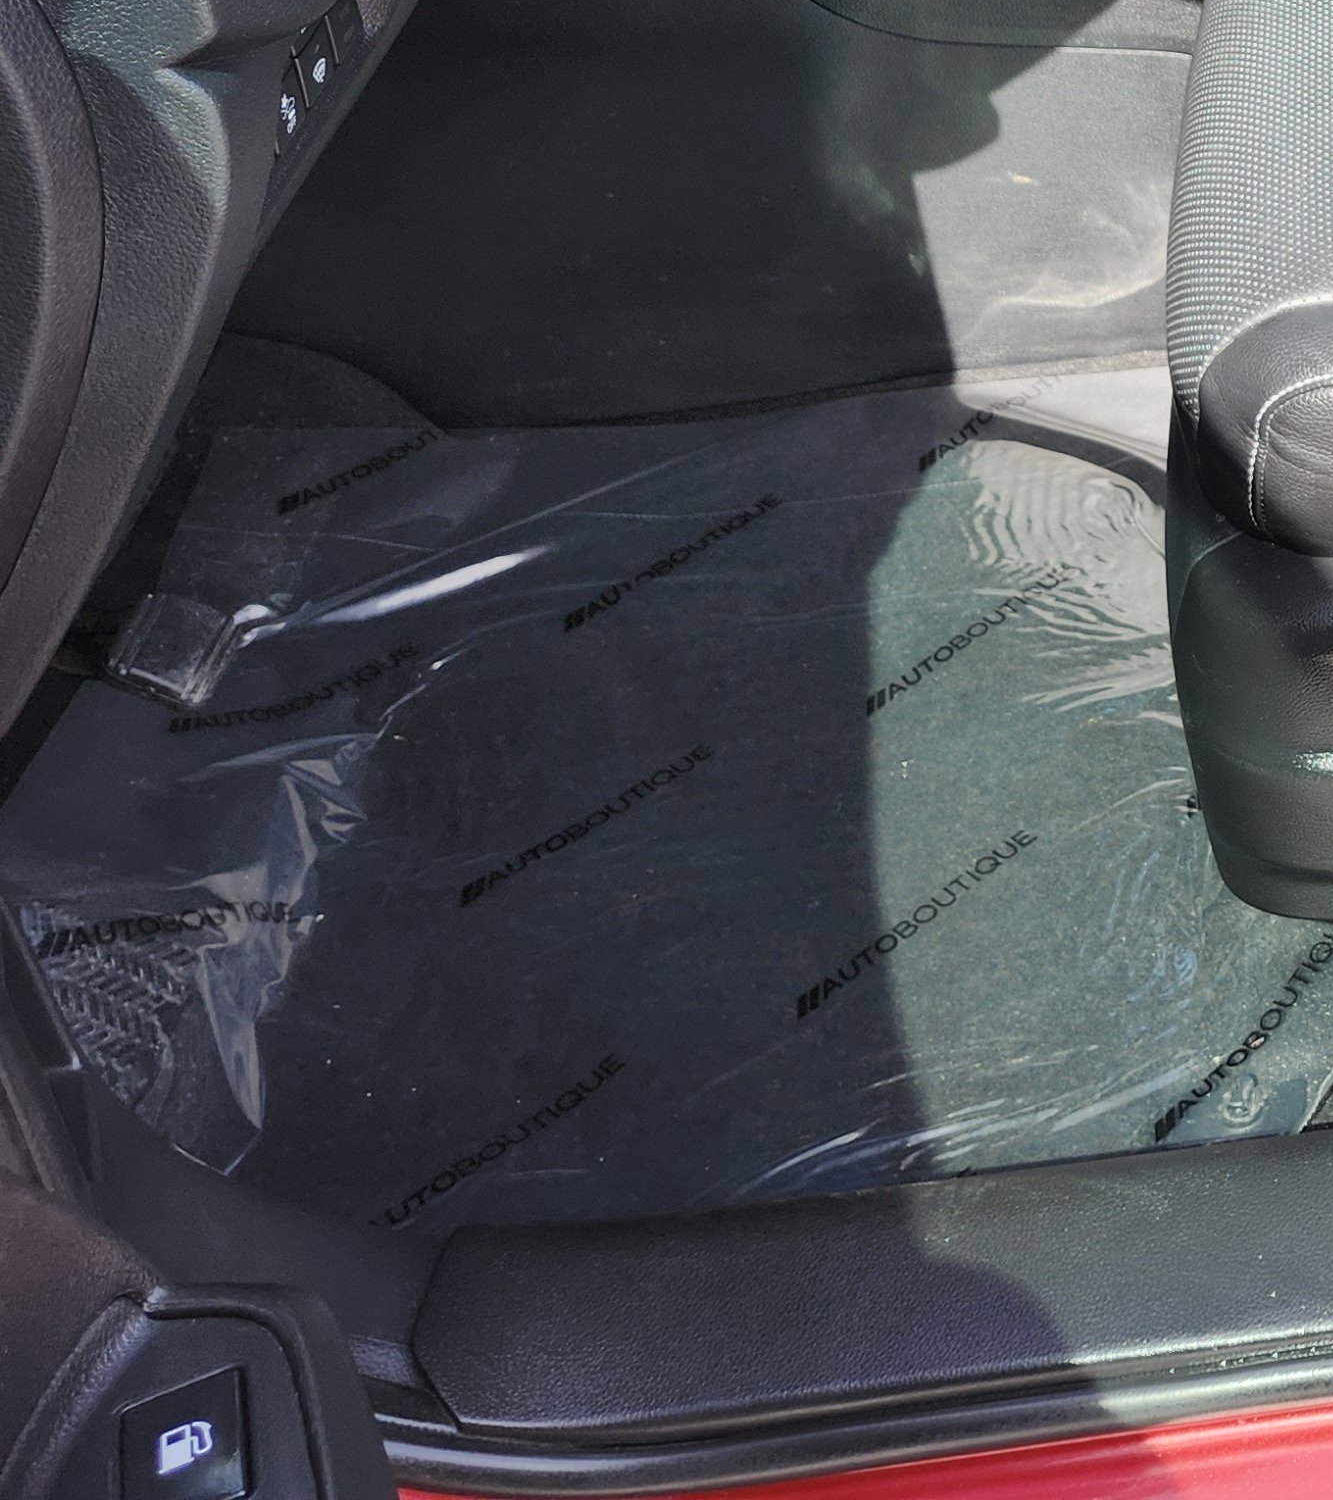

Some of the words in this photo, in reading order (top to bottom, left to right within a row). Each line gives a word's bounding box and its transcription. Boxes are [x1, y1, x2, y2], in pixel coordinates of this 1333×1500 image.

[486, 743, 715, 892] AUTOBOUTIQUE
[823, 829, 1039, 1000] AUTOBOUTIQUE
[380, 1052, 626, 1226] UTOBOUTIQUE
